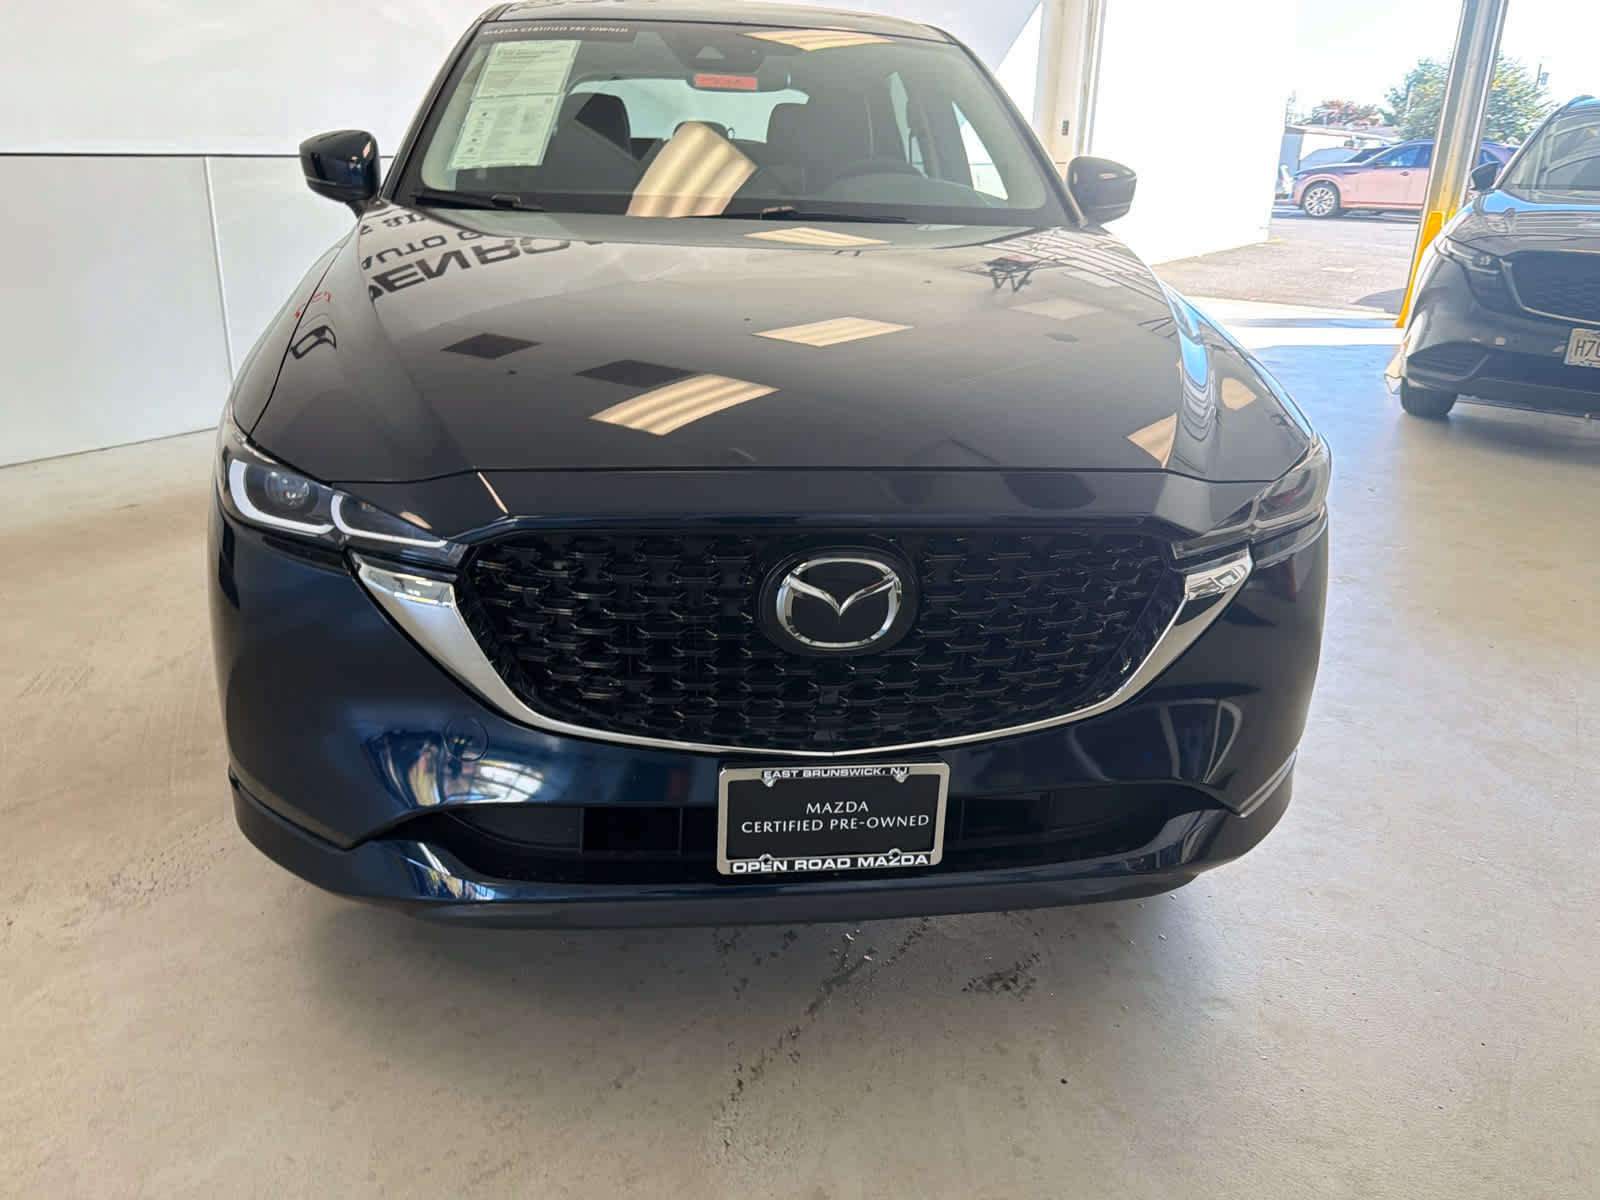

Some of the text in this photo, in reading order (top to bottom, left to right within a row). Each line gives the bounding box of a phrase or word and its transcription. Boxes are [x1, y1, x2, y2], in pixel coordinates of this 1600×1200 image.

[763, 767, 908, 779] EAST BRUNSWICK, NJ
[806, 801, 869, 815] MAZDA
[741, 814, 930, 834] CERTIFIED PRE-OWNED
[732, 854, 929, 873] OPEN ROAD MAZDA
